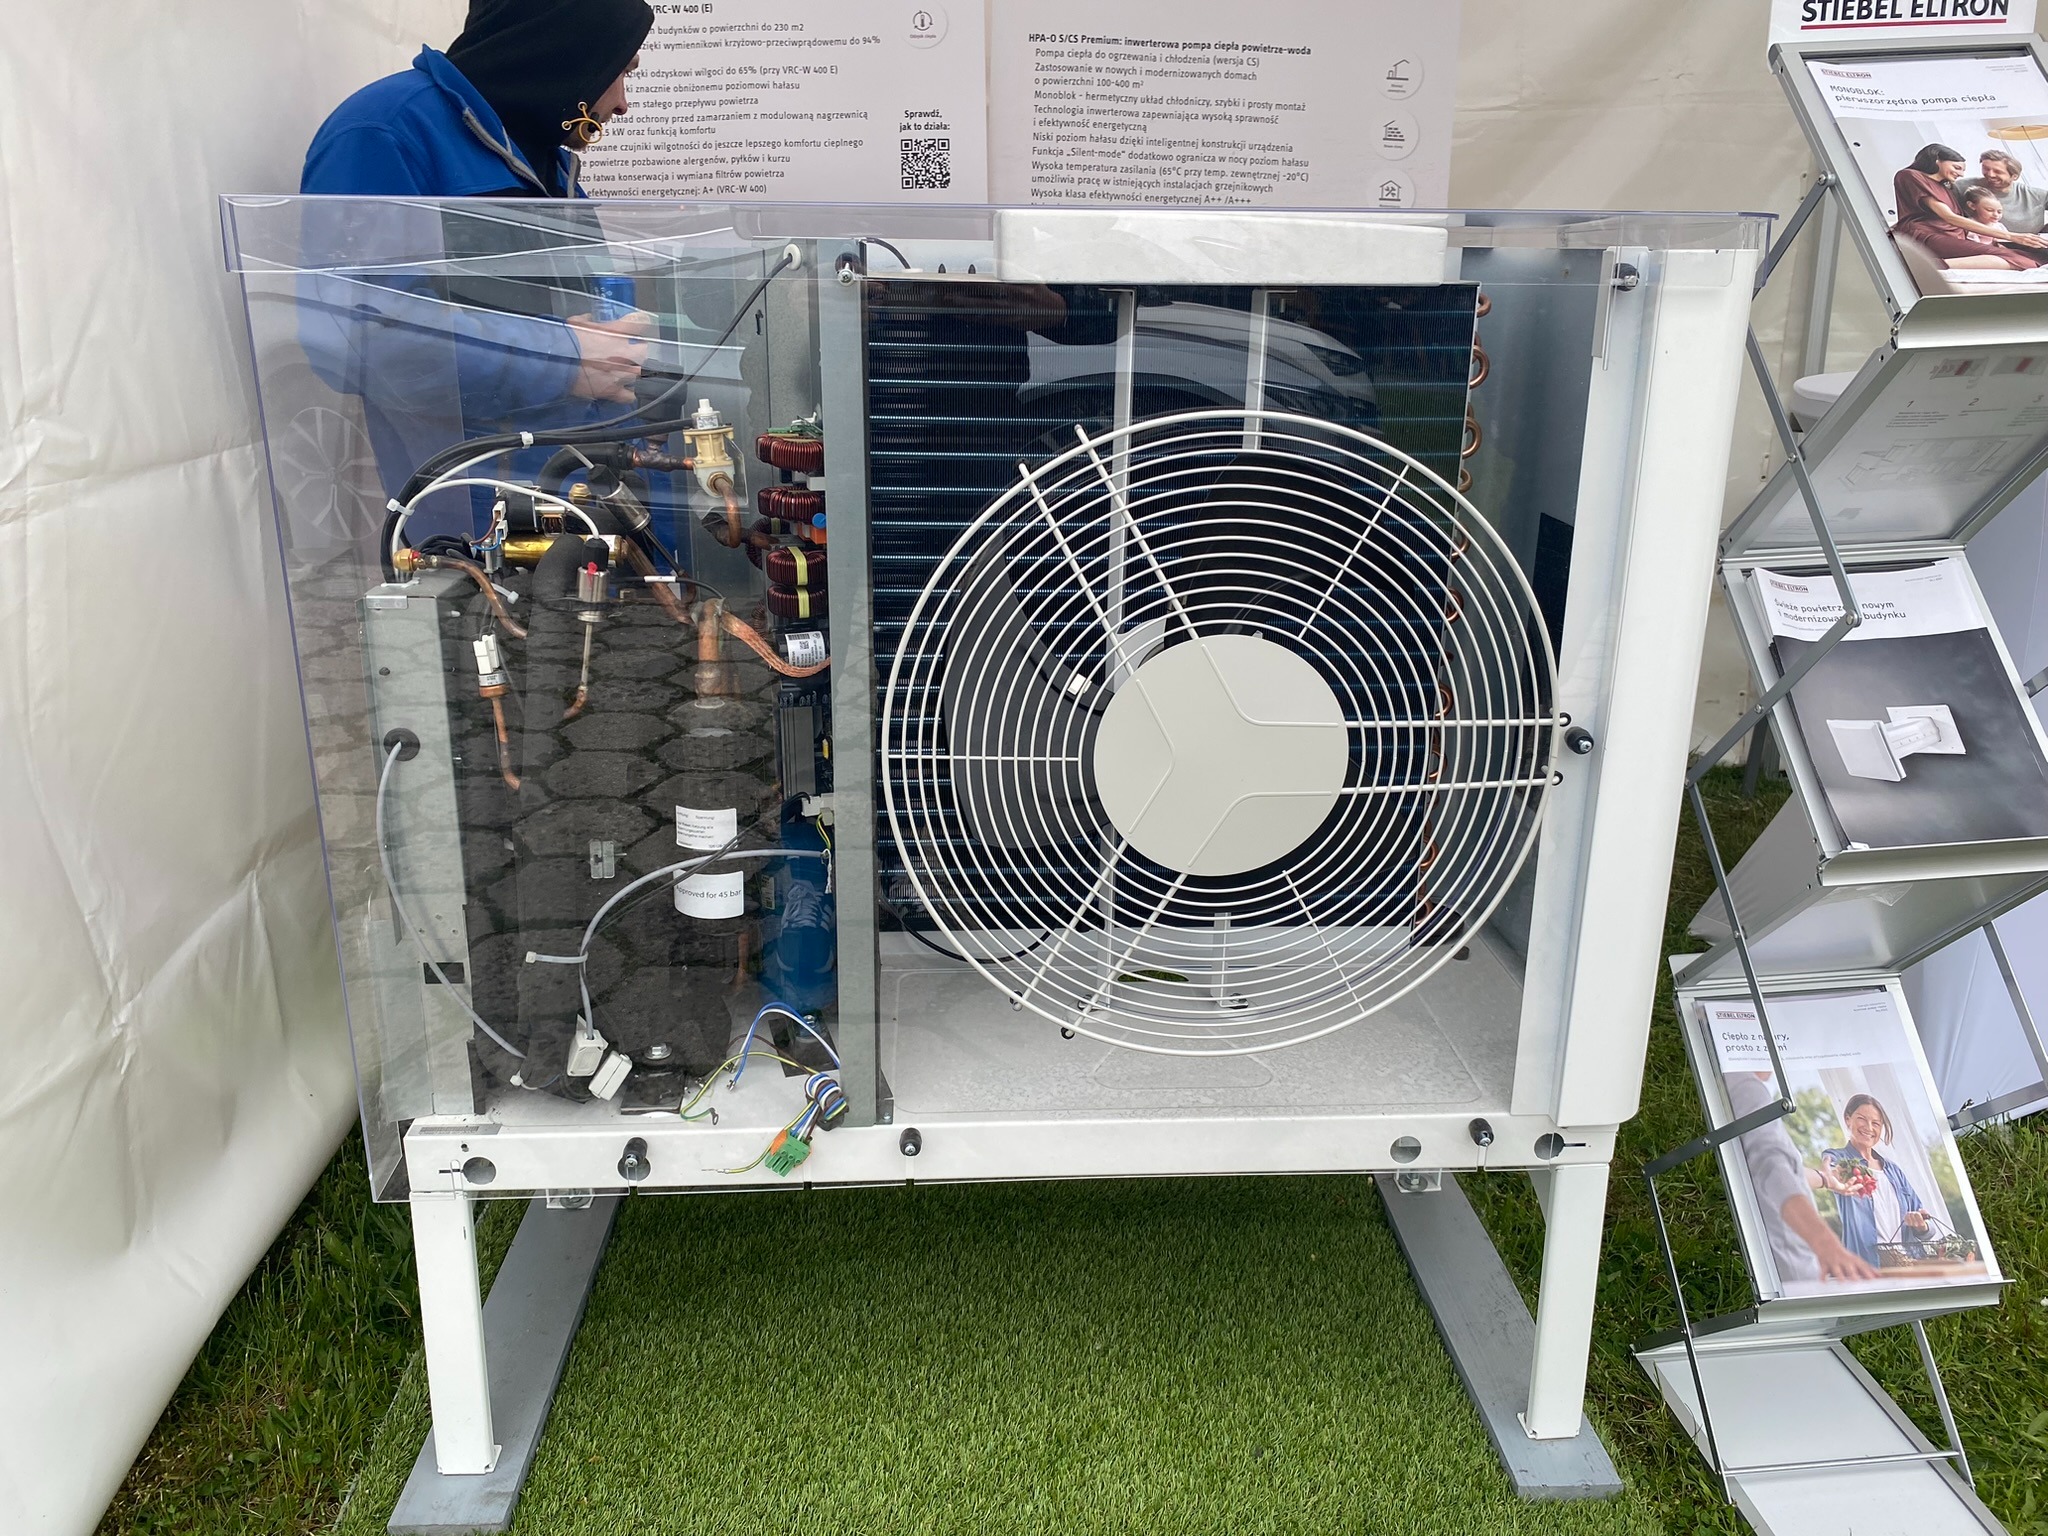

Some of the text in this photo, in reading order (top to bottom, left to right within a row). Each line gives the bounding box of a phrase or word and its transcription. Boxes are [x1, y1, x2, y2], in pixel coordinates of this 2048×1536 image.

[684, 5, 698, 13] 400
[702, 4, 712, 13] (E)
[1801, 0, 2008, 22] STIEBEL ELTRON
[658, 26, 700, 36] budynków
[710, 24, 758, 34] powierzchni
[761, 23, 772, 31] do
[663, 40, 722, 50] wymiennikowi
[850, 37, 860, 45] do
[862, 36, 880, 44] 94%
[1059, 34, 1078, 43] S/CS
[1081, 35, 1122, 44] Premium:
[1125, 37, 1179, 48] inwerterowa
[1214, 41, 1239, 51] ciepła
[1242, 44, 1311, 54] powietrze-woda
[1036, 48, 1259, 67] Pompa ciepła do ogrzewania chłodzenia (wersja CS)
[651, 69, 692, 78] odzyskowi
[695, 67, 723, 78] wilgoci
[726, 67, 736, 75] do
[739, 66, 757, 74] 65%
[760, 67, 780, 75] (przy
[782, 66, 811, 74] VRC-W
[830, 66, 838, 74] E)
[1035, 63, 1257, 80] Zastosowanie nowych modernizowanych domach
[673, 84, 723, 92] obniżonemu
[726, 83, 769, 91] poziomowi
[773, 81, 799, 89] hałasu
[1043, 76, 1129, 88] powierzchni 100-400
[1830, 86, 1884, 97] MONOBLOK:
[643, 100, 672, 109] stałego
[675, 100, 716, 108] przepływu
[719, 97, 758, 106] powietrza
[1034, 91, 1076, 99] Monoblok
[1086, 92, 1138, 104] hermetyczny
[1141, 95, 1163, 104] układ
[1215, 98, 1240, 108] szybki
[1248, 102, 1273, 111] prosty
[1275, 103, 1305, 111] montaż
[1835, 93, 1917, 107] pierwszorzędna
[610, 114, 633, 123] układ
[672, 114, 694, 124] przed
[760, 112, 814, 121] modulowaną
[817, 112, 867, 121] nagrzewnicą
[905, 109, 942, 118] Sprawdź,
[1034, 105, 1278, 124] Technologia inwerterowa zapewniająca wysoką sprawność
[647, 127, 677, 137] funkcją
[680, 126, 715, 134] komfortu
[900, 123, 912, 132] jak
[924, 122, 950, 130] działa:
[1039, 118, 1146, 133] efektywność energetyczną
[620, 139, 863, 152] czujniki wilgotności do jeszcze lepszego komfortu cieplnego
[1033, 132, 1293, 152] Niski poziom hałasu dzięki inteligentnej konstrukcji urządzenia
[632, 158, 680, 167] pozbawione
[731, 154, 759, 164] pyłków
[1033, 147, 1309, 167] Funkcja dodatkowo ogranicza nocy poziom hałasu
[618, 173, 669, 181] konserwacja
[677, 172, 713, 181] wymiana
[716, 170, 742, 178] filtrów
[745, 169, 784, 178] powietrza
[1032, 161, 1063, 170] Wysoka
[1066, 163, 1117, 172] temperatura
[1120, 165, 1156, 174] zasilania
[1204, 169, 1228, 178] temp.
[1231, 171, 1280, 183] zewnętrznej
[1032, 174, 1074, 183] umożliwia
[1113, 177, 1160, 189] istniejących
[1163, 180, 1212, 190] instalacjach
[1215, 182, 1273, 194] grzejnikowych
[586, 188, 638, 198] efektywności
[642, 189, 700, 197] energetycznej:
[717, 185, 747, 193] (VRC-W
[750, 185, 766, 193] 400)
[1031, 189, 1062, 198] Wysoka
[1066, 189, 1086, 198] klasa
[1089, 190, 1142, 202] efektywności
[1144, 195, 1202, 205] energetycznej
[1801, 605, 1845, 613] powietrz
[1784, 612, 1906, 623] modernizowa budynku
[706, 890, 716, 898] for
[730, 888, 741, 896] bar
[1722, 1032, 1748, 1040] Ciepło
